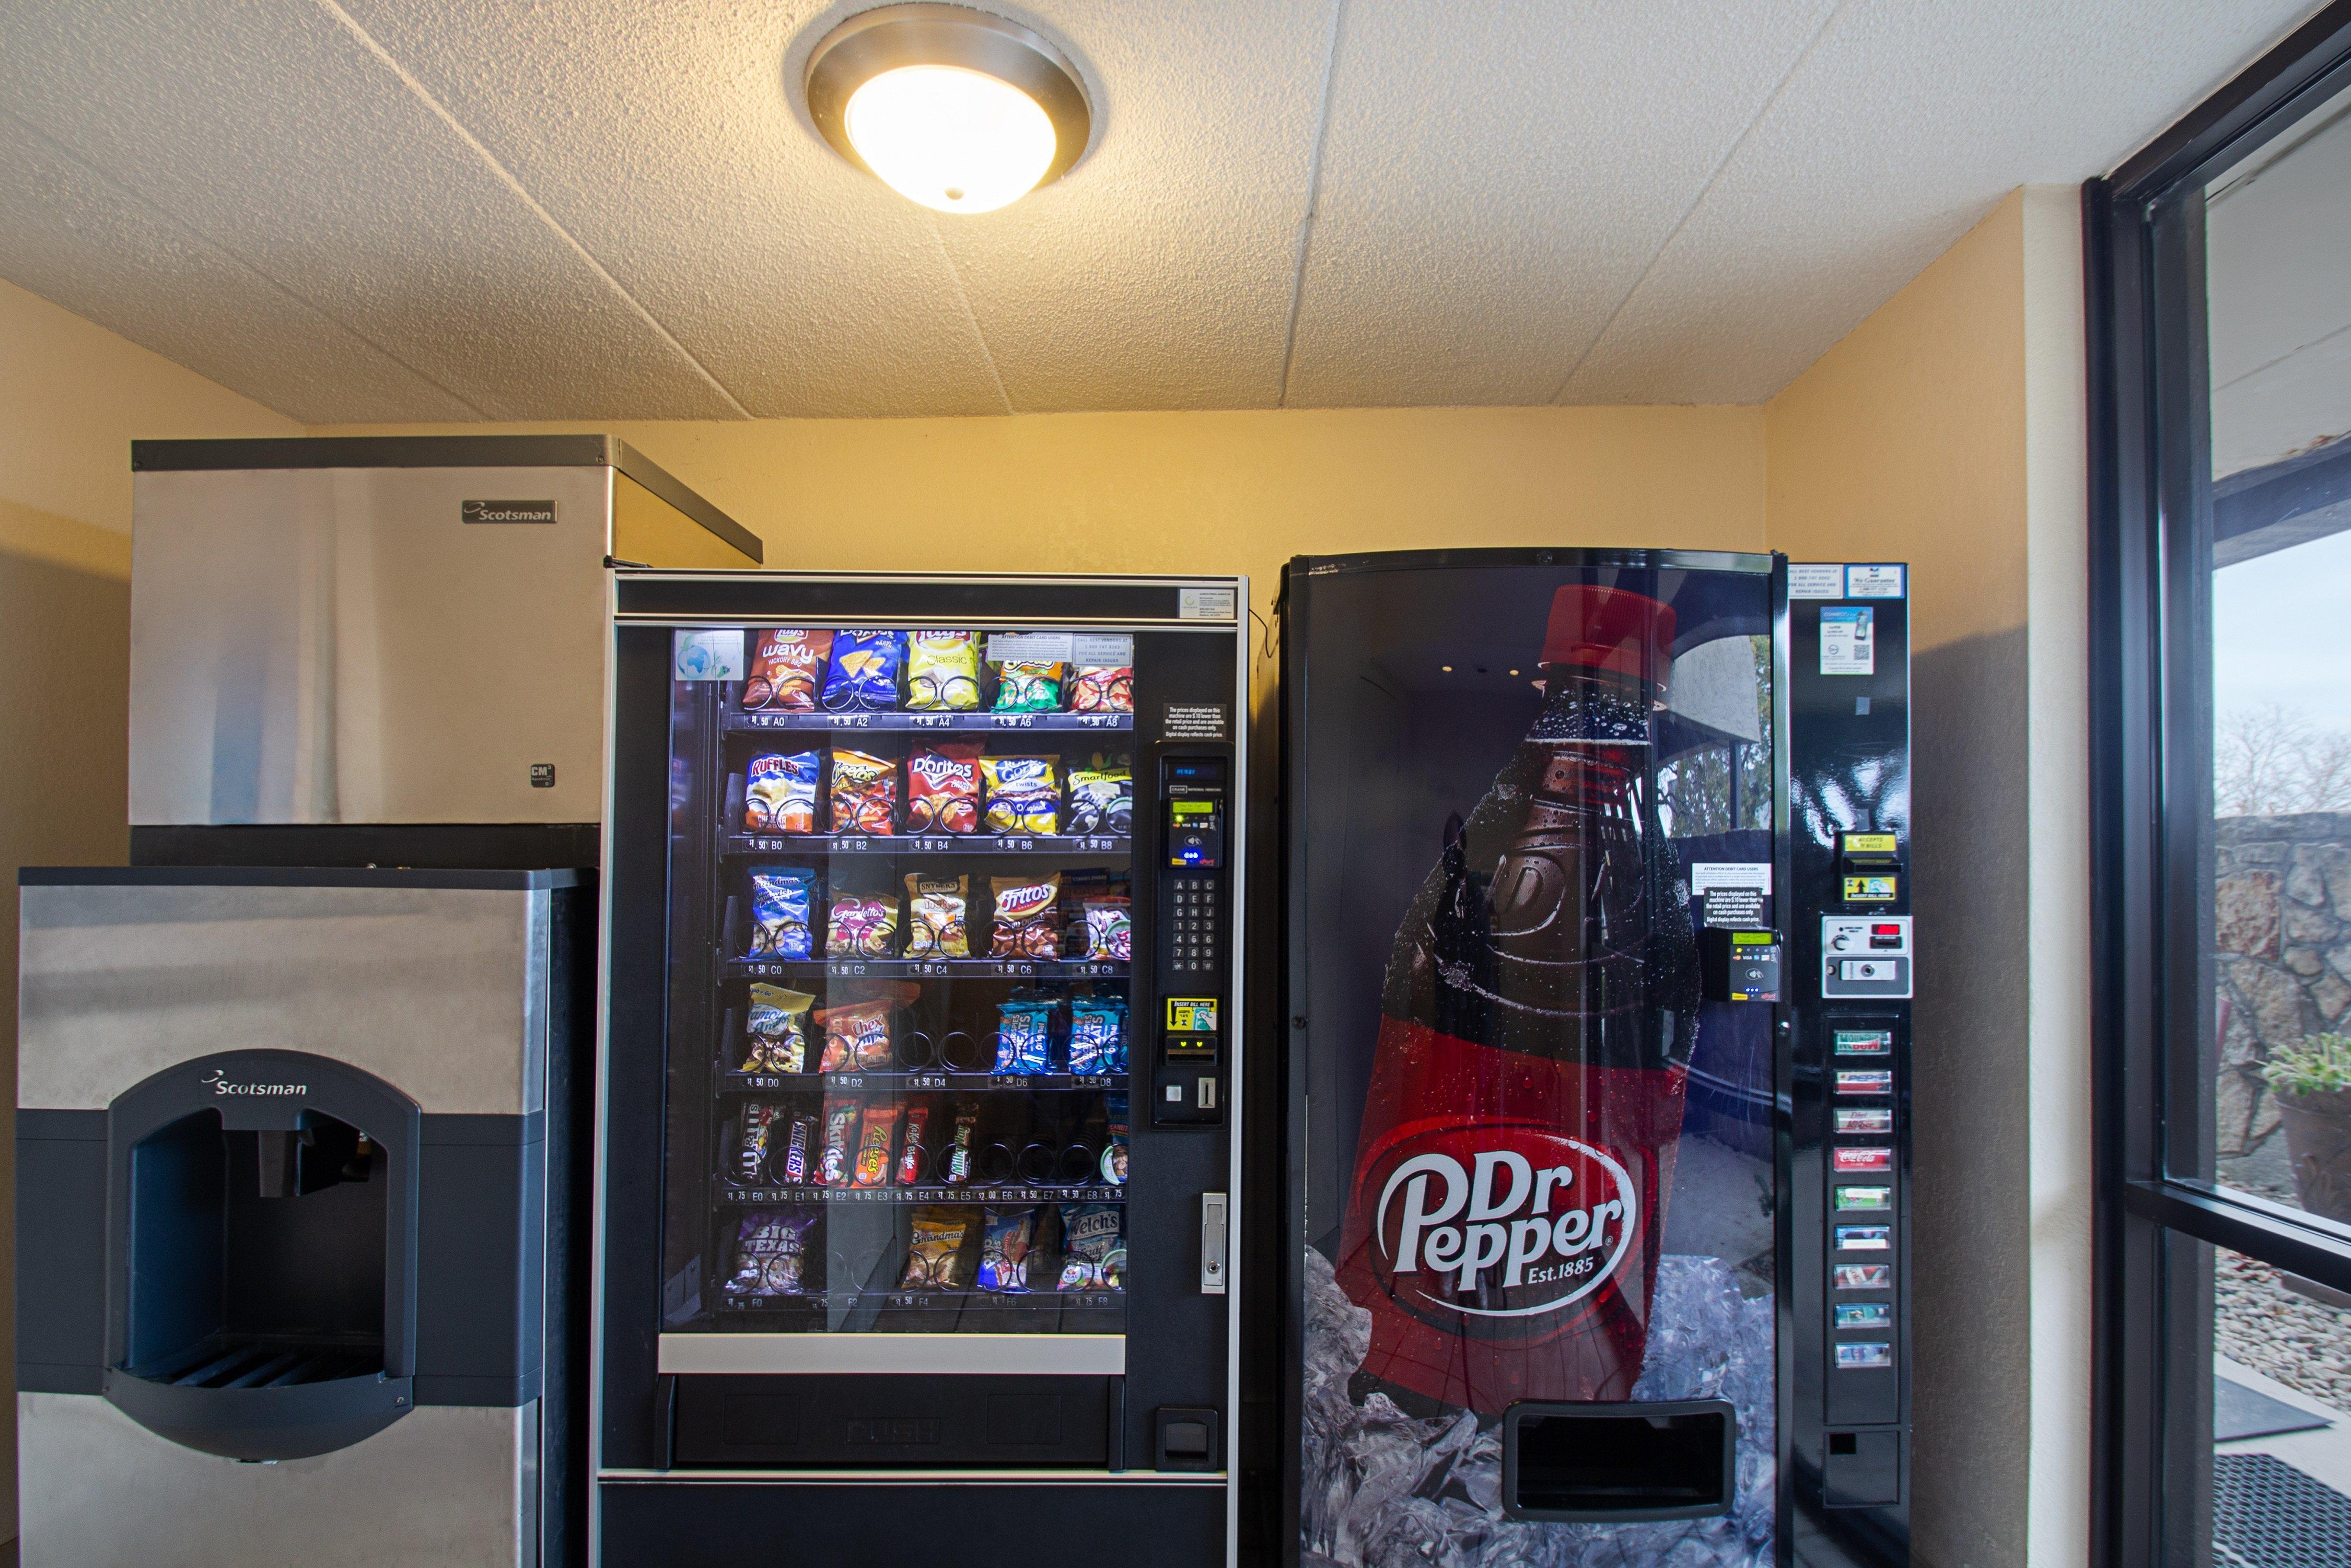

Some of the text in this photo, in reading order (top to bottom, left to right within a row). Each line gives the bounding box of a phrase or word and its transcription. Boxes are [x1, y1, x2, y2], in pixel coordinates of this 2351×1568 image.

[479, 510, 551, 520] Scotsman
[768, 657, 790, 665] HICKORY
[927, 654, 968, 665] Classic
[773, 718, 785, 727] A0
[857, 718, 868, 727] A2
[939, 718, 950, 727] A4
[1020, 718, 1031, 727] A6
[1106, 718, 1118, 727] A8
[752, 758, 799, 776] RUFFLES
[912, 758, 972, 777] Doritos
[1073, 770, 1126, 786] Smartfood
[772, 841, 782, 850] B0
[856, 841, 867, 850] B2
[938, 841, 948, 850] B4
[1101, 841, 1112, 850] B8
[1002, 884, 1050, 911] Fritos
[771, 966, 782, 975] C0
[854, 966, 865, 975] C2
[936, 966, 947, 974] C4
[1020, 965, 1032, 974] C6
[1102, 965, 1113, 974] C8
[853, 1014, 883, 1035] Chex
[768, 1079, 779, 1087] D0
[851, 1079, 863, 1087] D2
[935, 1079, 946, 1087] D4
[1016, 1078, 1028, 1086] D6
[1100, 1078, 1111, 1086] D8
[215, 1080, 307, 1095] Scotsman
[955, 1125, 971, 1144] Way
[788, 1122, 807, 1178] SNICKERS
[824, 1113, 845, 1181] Skittles
[868, 1126, 887, 1174] Reese's
[951, 1145, 969, 1176] Milky
[1466, 1150, 1573, 1221] Dr
[752, 1192, 763, 1201] E0
[795, 1192, 804, 1201] E1
[836, 1192, 846, 1200] E2
[878, 1192, 888, 1200] E3
[919, 1192, 929, 1200] E4
[961, 1191, 971, 1200] E5
[1003, 1191, 1012, 1200] E6
[1378, 1153, 1623, 1292] Pepper
[751, 1225, 797, 1241] BIG
[911, 1230, 965, 1245] Grandma's
[744, 1239, 800, 1253] TEXAS
[919, 1298, 928, 1306] F4
[1098, 1297, 1108, 1305] F8
